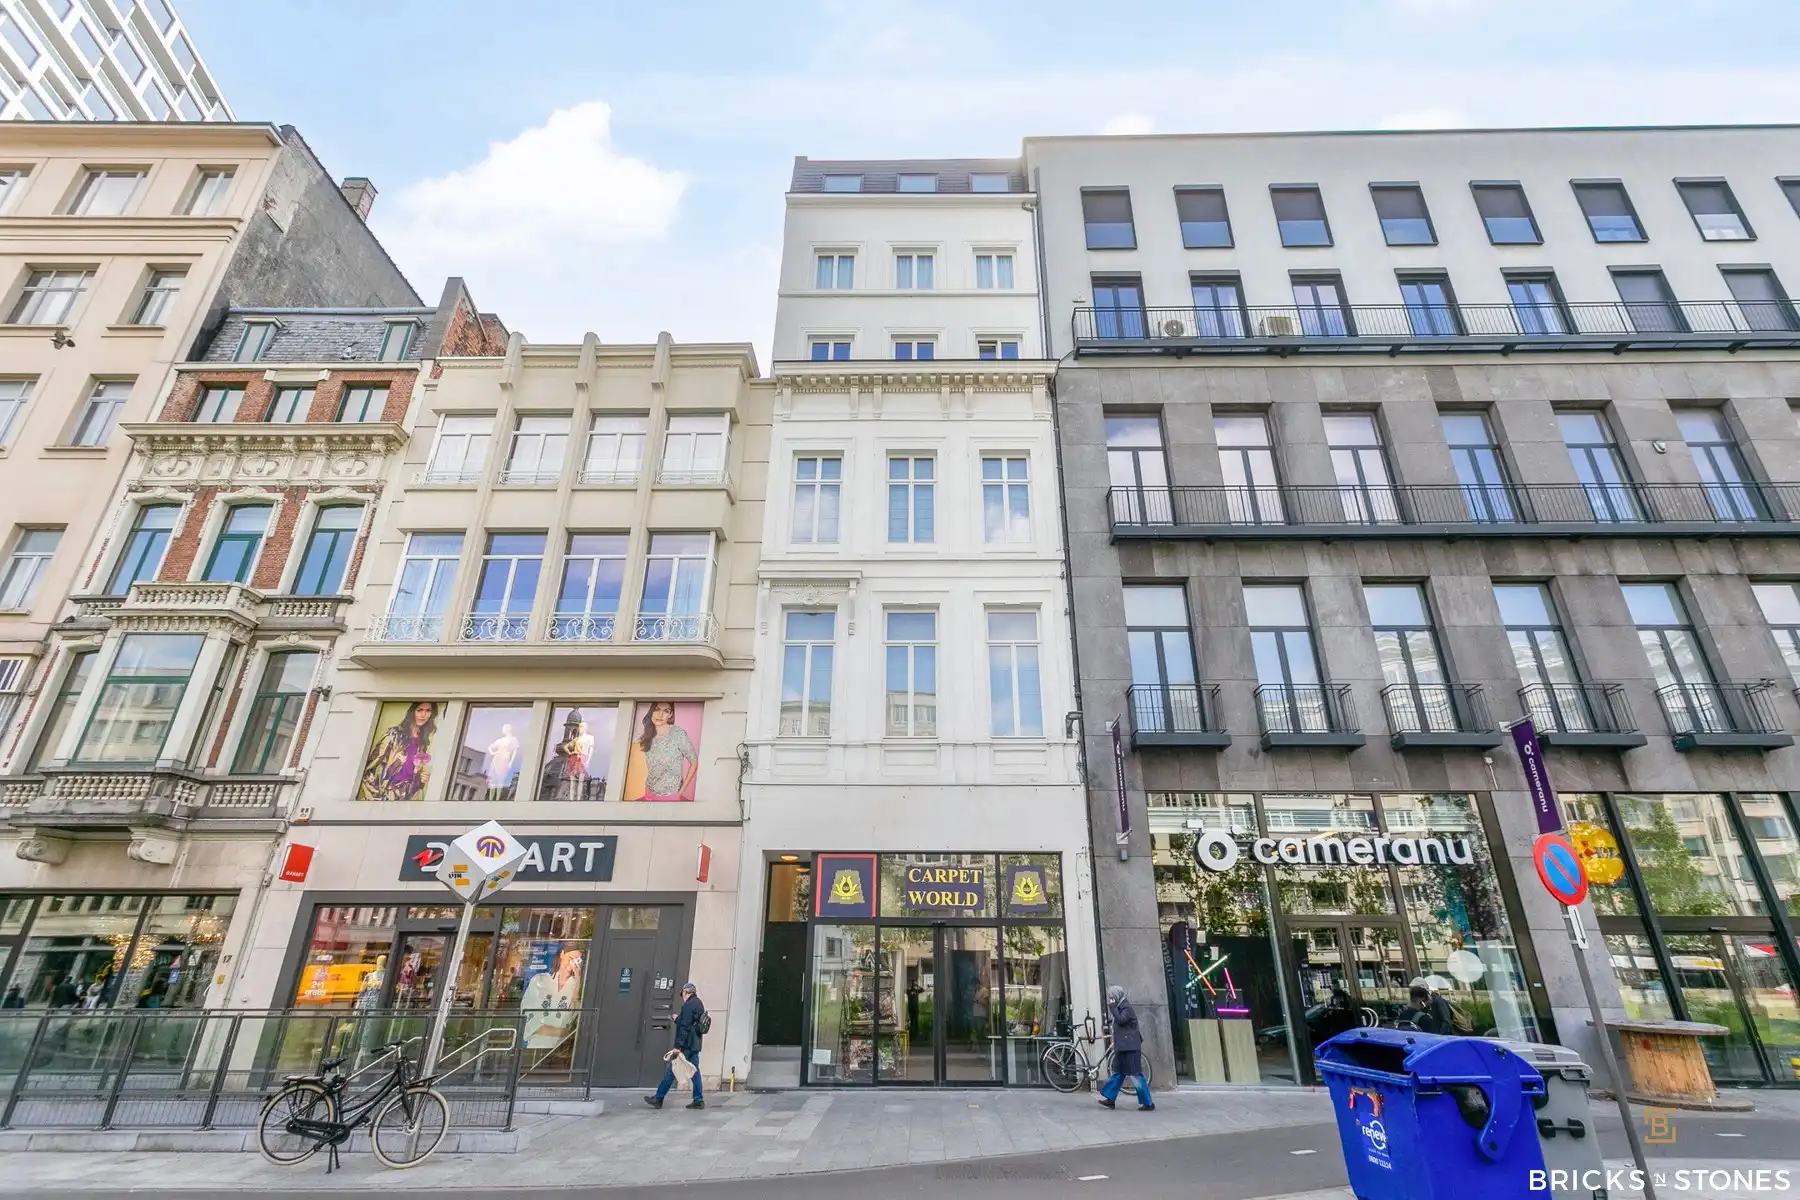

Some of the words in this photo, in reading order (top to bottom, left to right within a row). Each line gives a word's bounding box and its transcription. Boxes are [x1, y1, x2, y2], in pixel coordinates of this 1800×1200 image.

[1529, 757, 1549, 813] cameranu
[413, 841, 605, 873] DART
[1254, 836, 1475, 865] cameranu
[908, 867, 983, 885] CARPET
[907, 890, 979, 907] WORLD
[222, 954, 233, 964] 17
